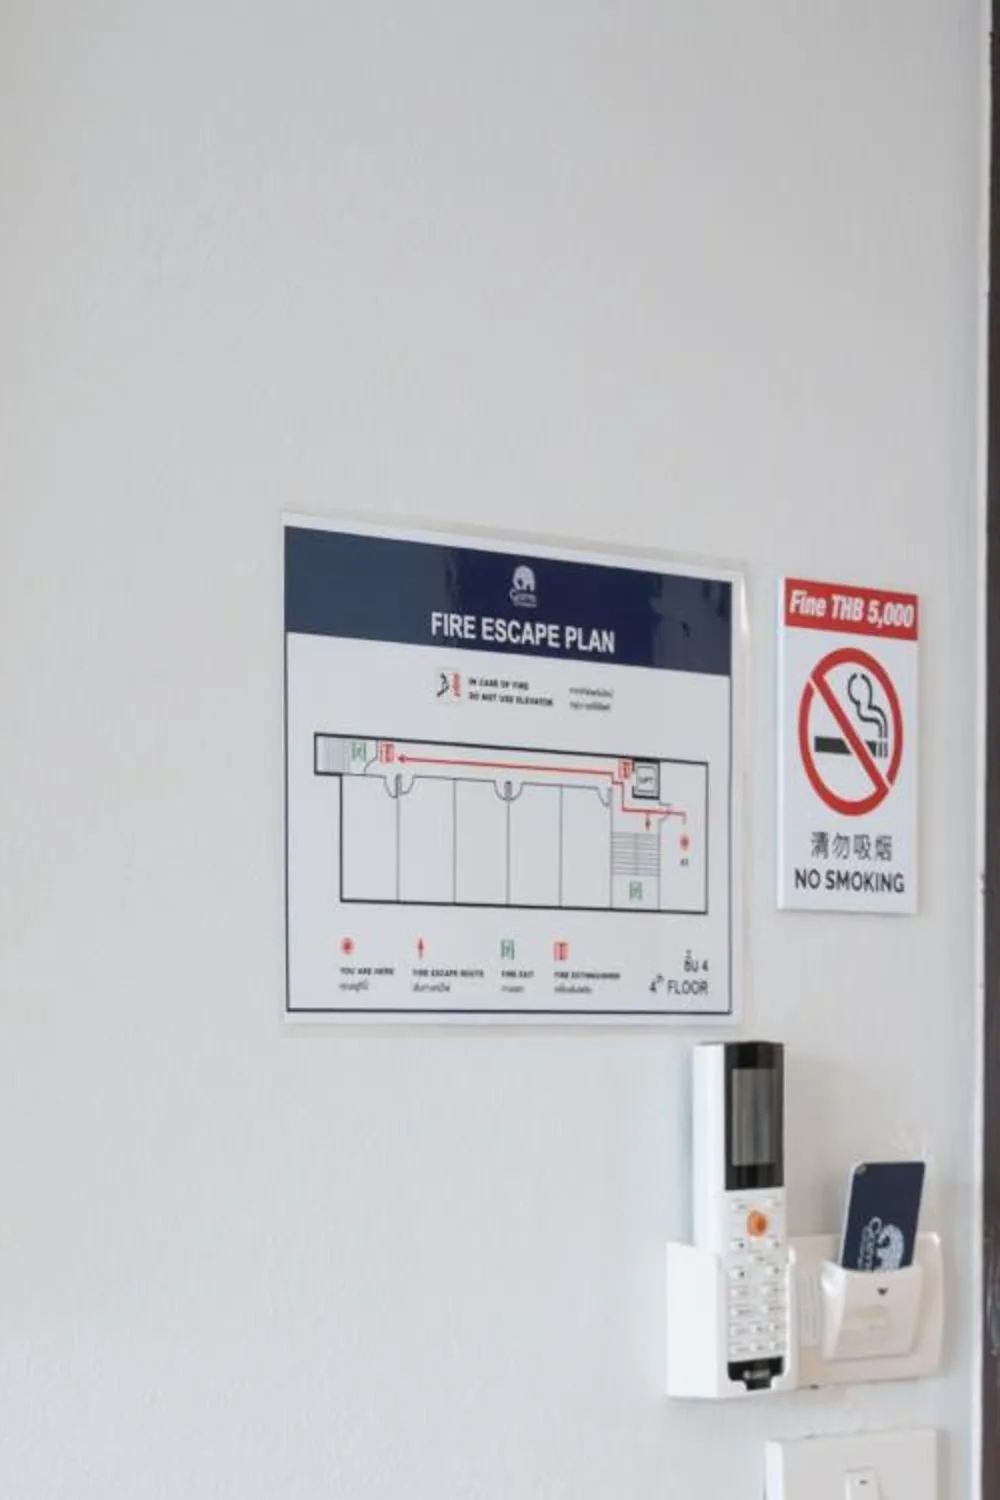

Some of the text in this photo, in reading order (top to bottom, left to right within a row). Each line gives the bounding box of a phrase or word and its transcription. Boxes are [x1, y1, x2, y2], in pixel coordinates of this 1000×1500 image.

[789, 589, 914, 628] Fine THB 5,000
[431, 611, 615, 654] FIRE ESCAPE PLAN
[794, 867, 905, 893] NO SMOKING
[667, 979, 708, 996] FLOOR
